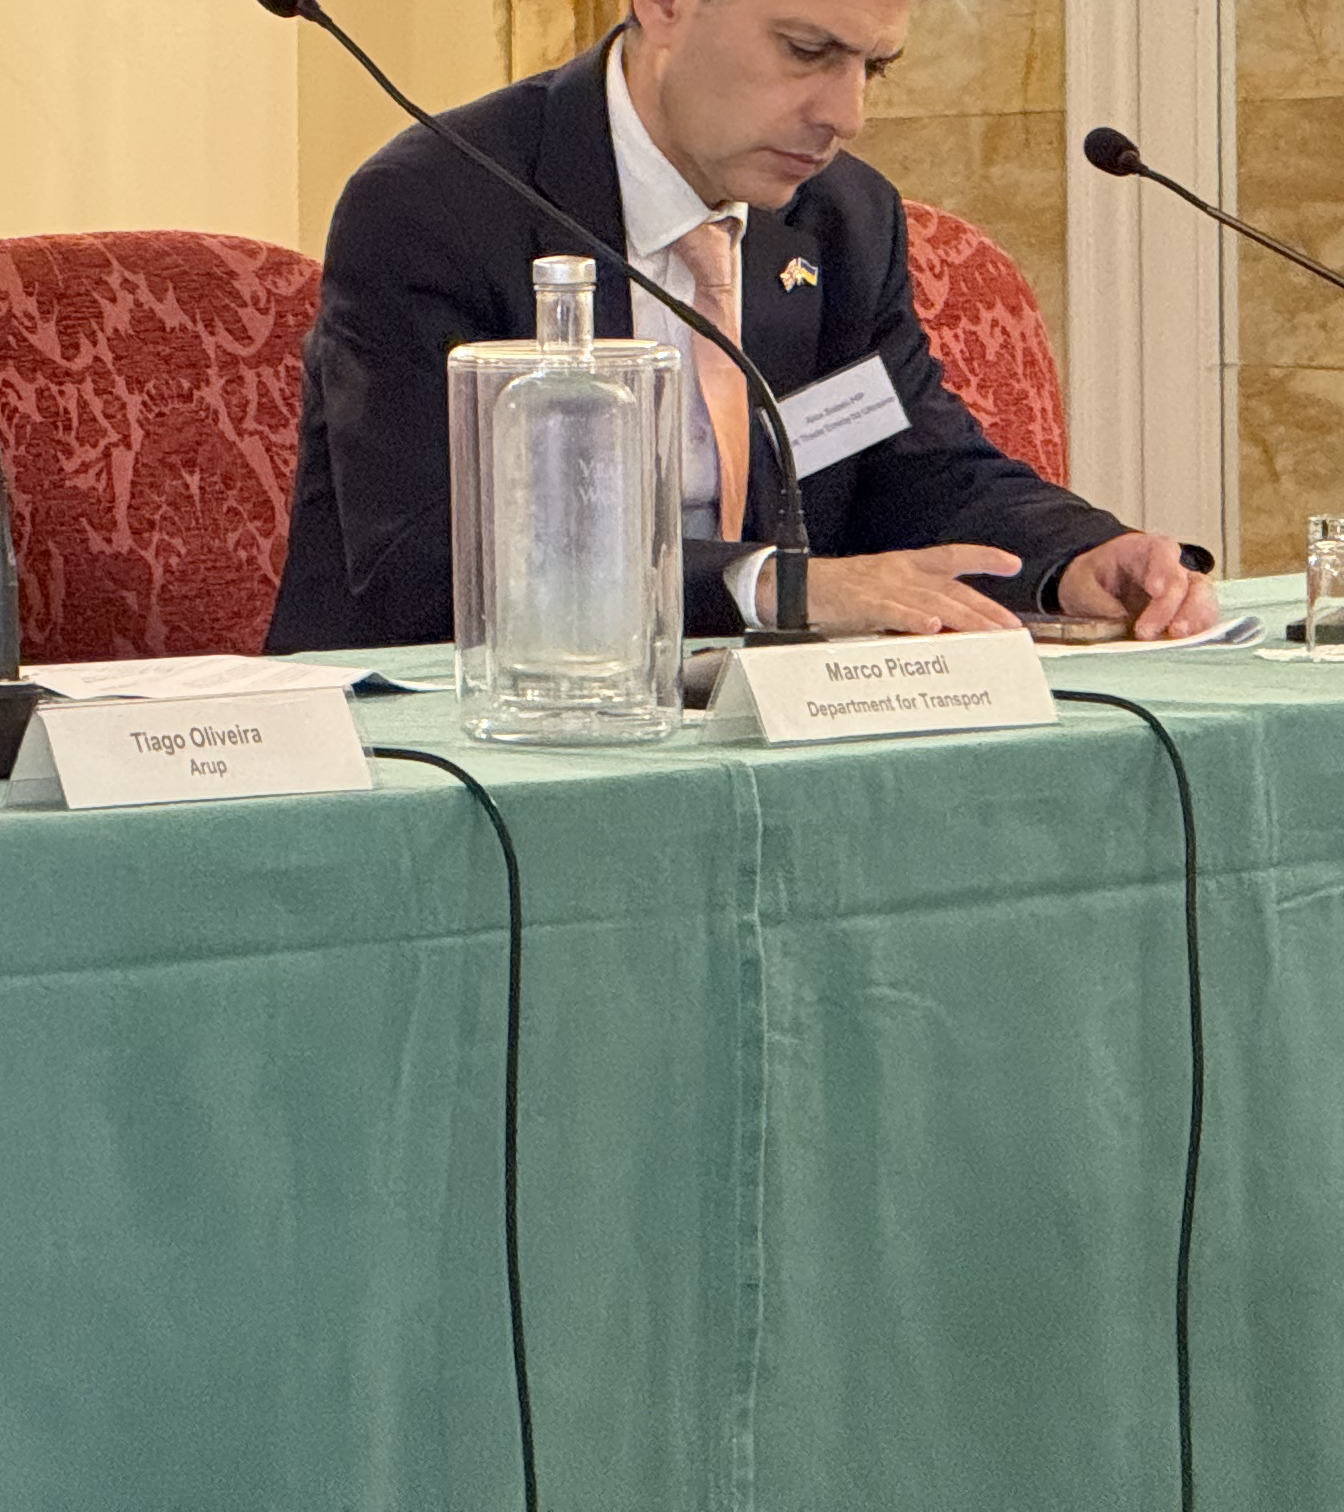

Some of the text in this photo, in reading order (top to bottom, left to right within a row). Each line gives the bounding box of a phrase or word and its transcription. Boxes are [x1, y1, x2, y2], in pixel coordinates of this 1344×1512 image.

[826, 655, 950, 682] Marco Picardi
[807, 690, 992, 720] Department for Transport
[130, 725, 262, 756] Tiago Oliveira
[189, 758, 228, 777] Arup
